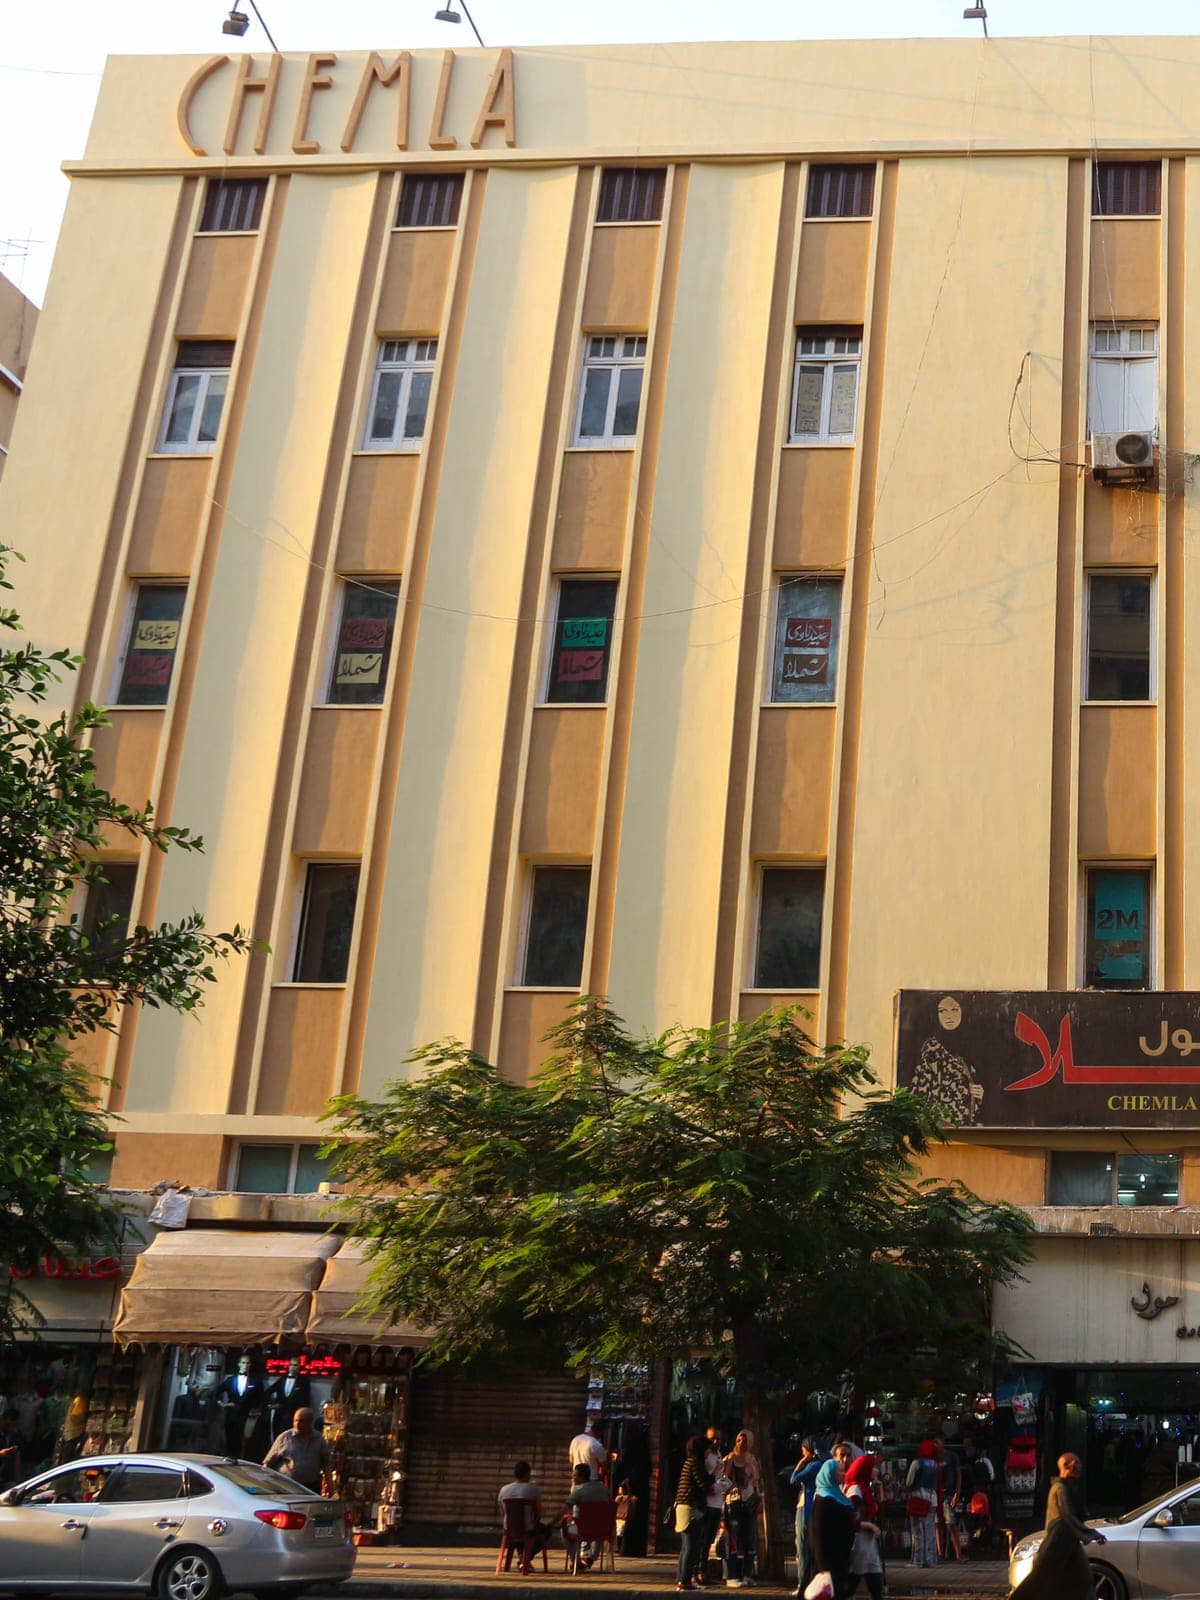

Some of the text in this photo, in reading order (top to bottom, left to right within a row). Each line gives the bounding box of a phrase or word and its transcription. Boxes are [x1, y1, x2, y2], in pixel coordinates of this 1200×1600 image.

[177, 48, 517, 157] CHEMLA
[336, 654, 382, 678] شملا
[783, 657, 829, 679] شملا
[1097, 908, 1139, 930] 2M
[1106, 1095, 1198, 1112] CHEMLA
